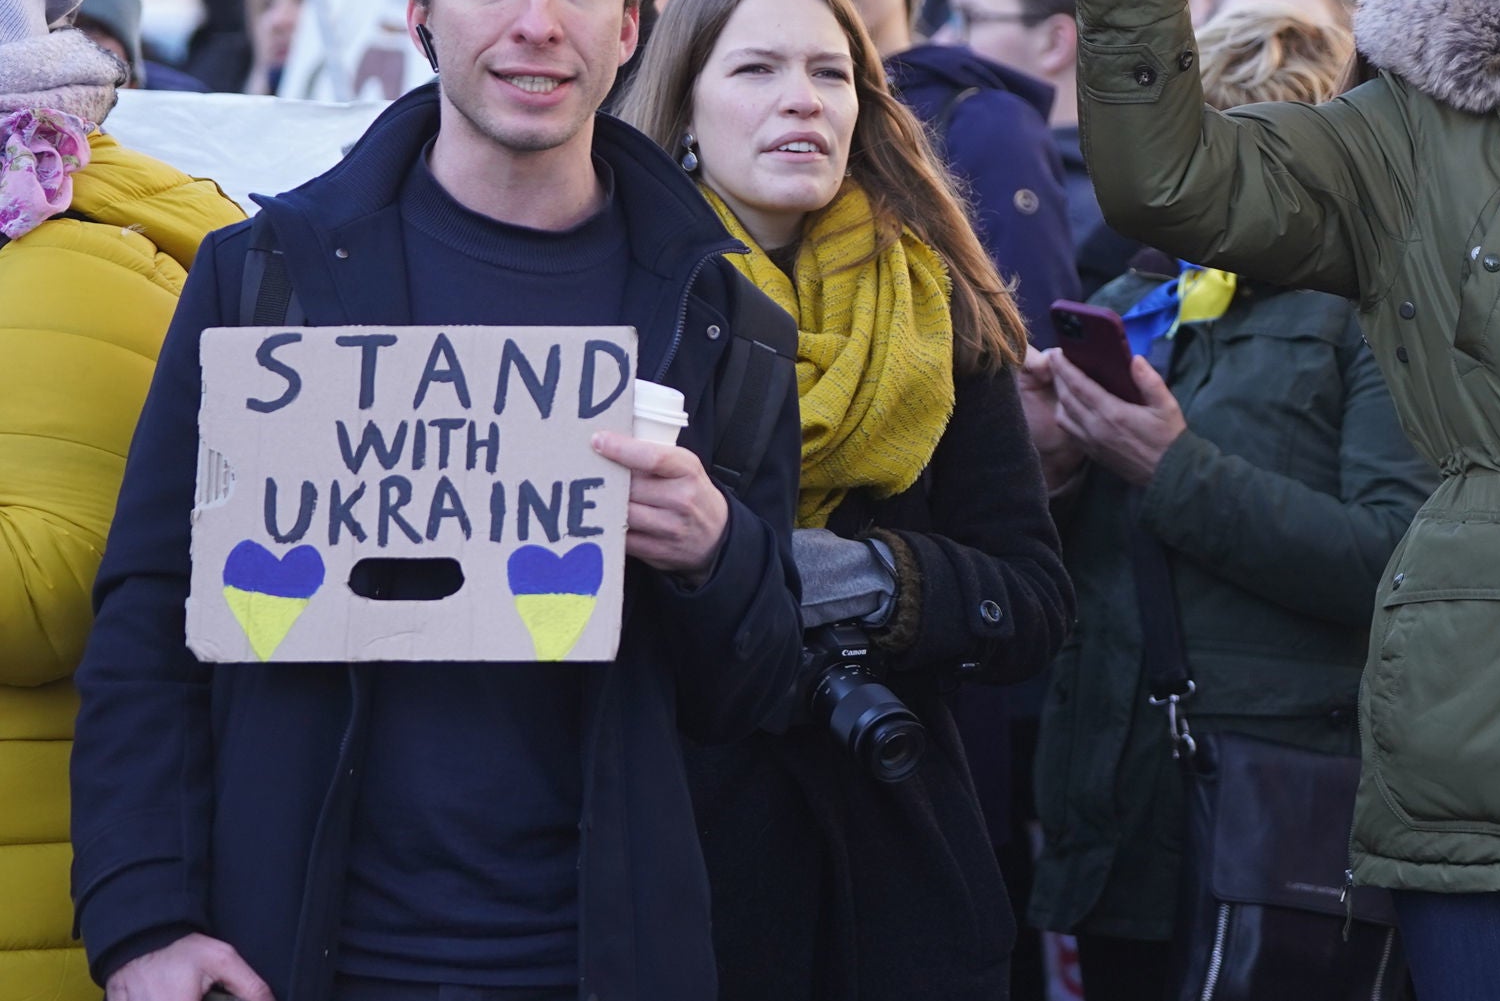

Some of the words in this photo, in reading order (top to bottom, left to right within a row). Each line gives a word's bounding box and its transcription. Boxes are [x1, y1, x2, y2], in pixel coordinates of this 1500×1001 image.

[246, 332, 630, 419] STAND
[335, 417, 500, 475] WITH
[263, 474, 605, 547] UKRAINE
[841, 649, 867, 657] Canon
